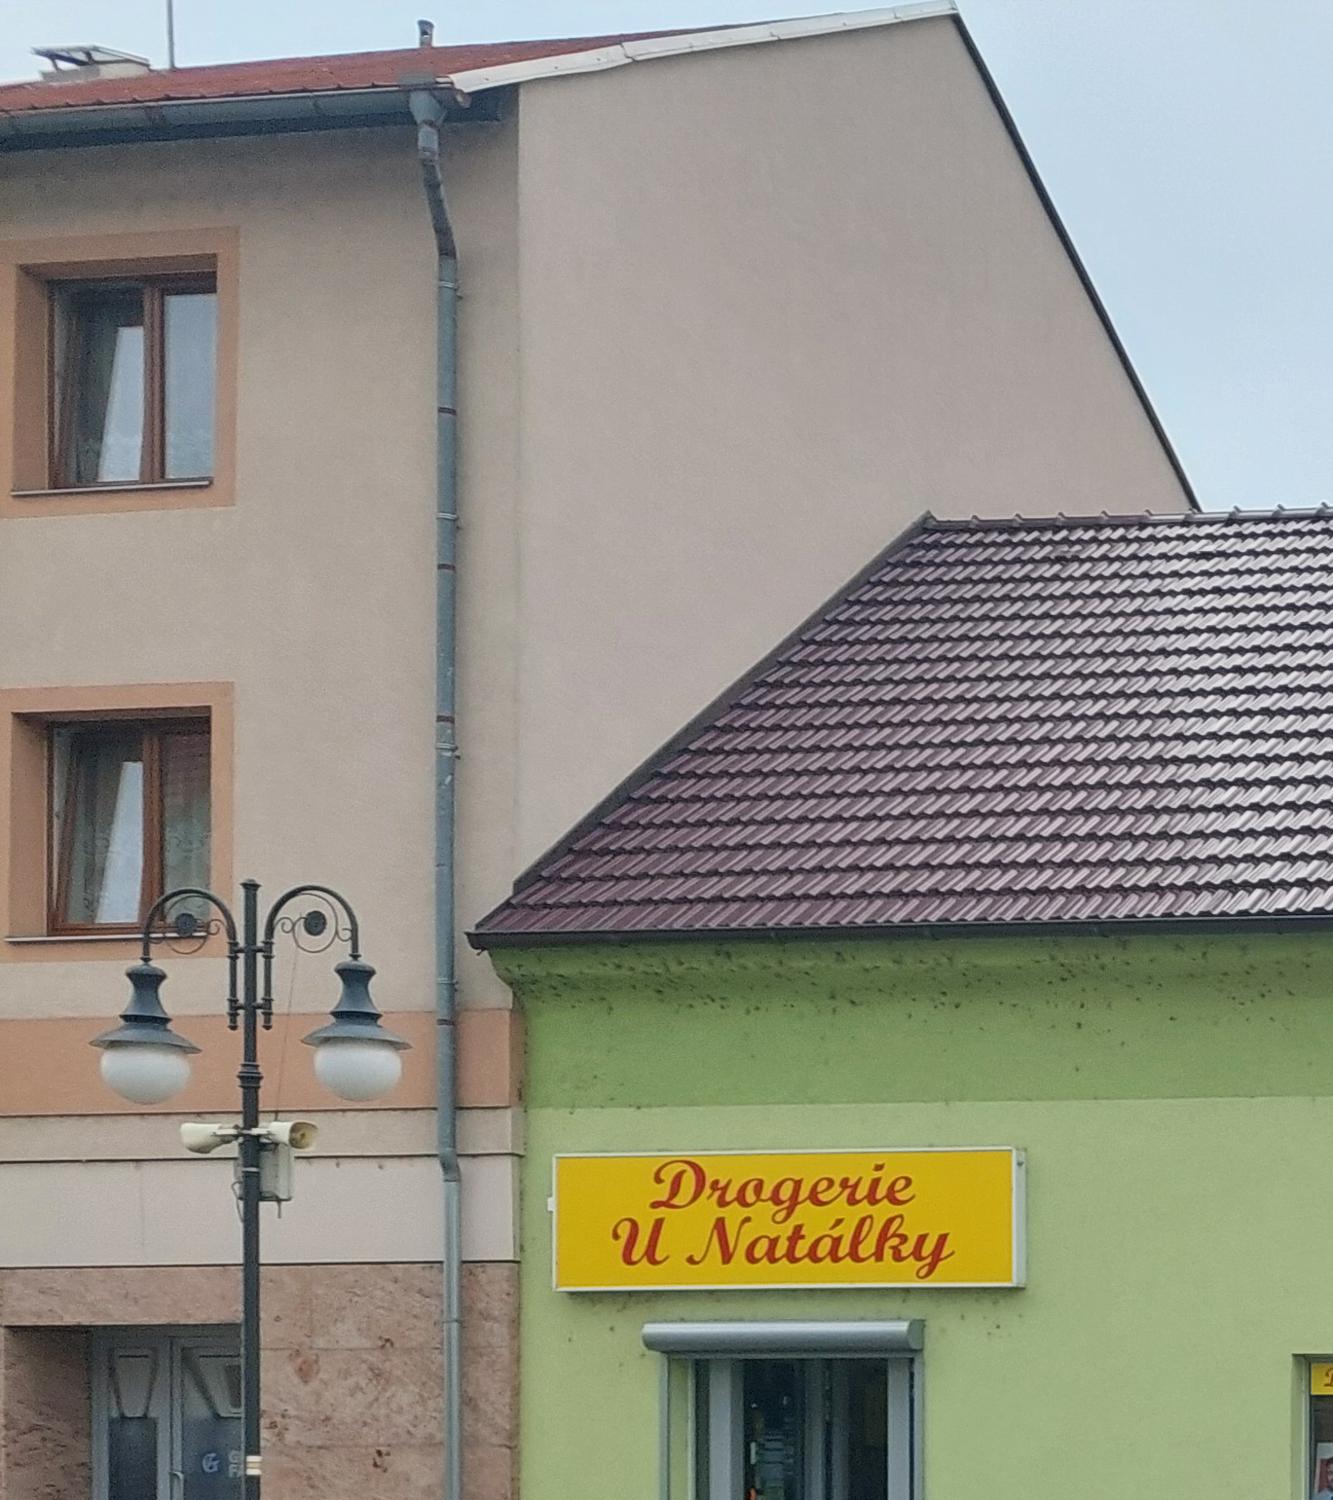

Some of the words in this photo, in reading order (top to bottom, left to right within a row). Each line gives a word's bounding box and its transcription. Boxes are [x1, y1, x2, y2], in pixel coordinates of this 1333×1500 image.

[649, 1158, 916, 1221] Drogerie
[611, 1216, 671, 1267] U
[685, 1213, 955, 1279] Natálky
